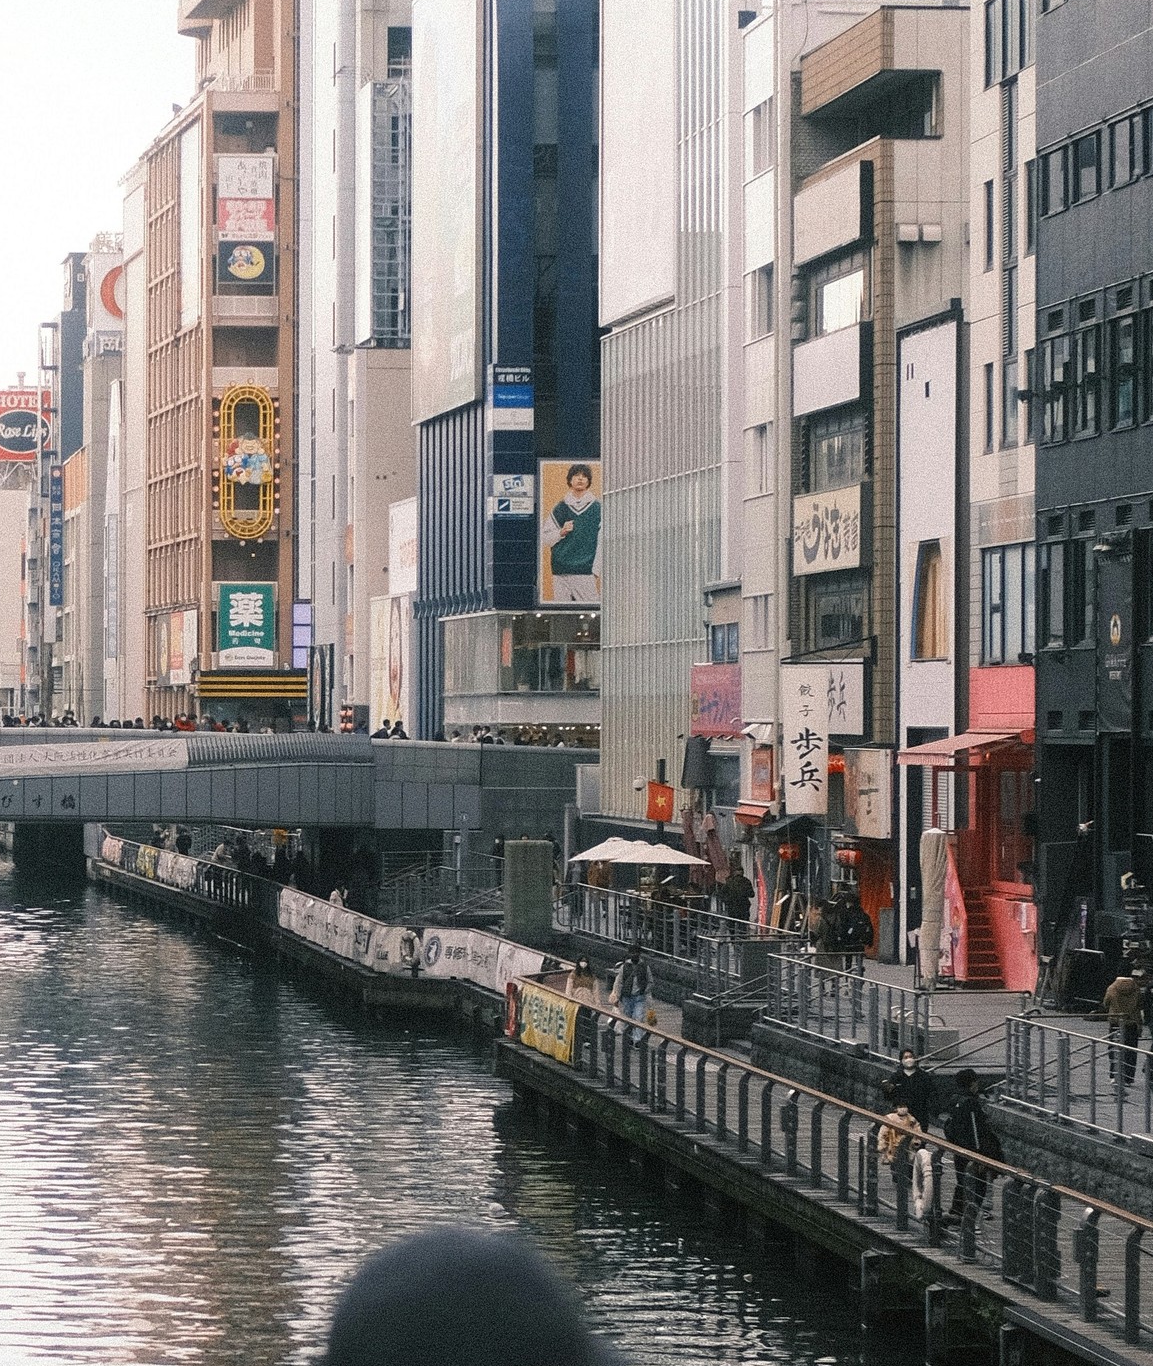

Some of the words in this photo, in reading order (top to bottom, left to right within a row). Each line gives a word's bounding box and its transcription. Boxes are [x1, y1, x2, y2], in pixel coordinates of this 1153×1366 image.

[230, 592, 263, 627] 薬
[798, 684, 815, 717] 餃子
[790, 727, 824, 792] 歩兵
